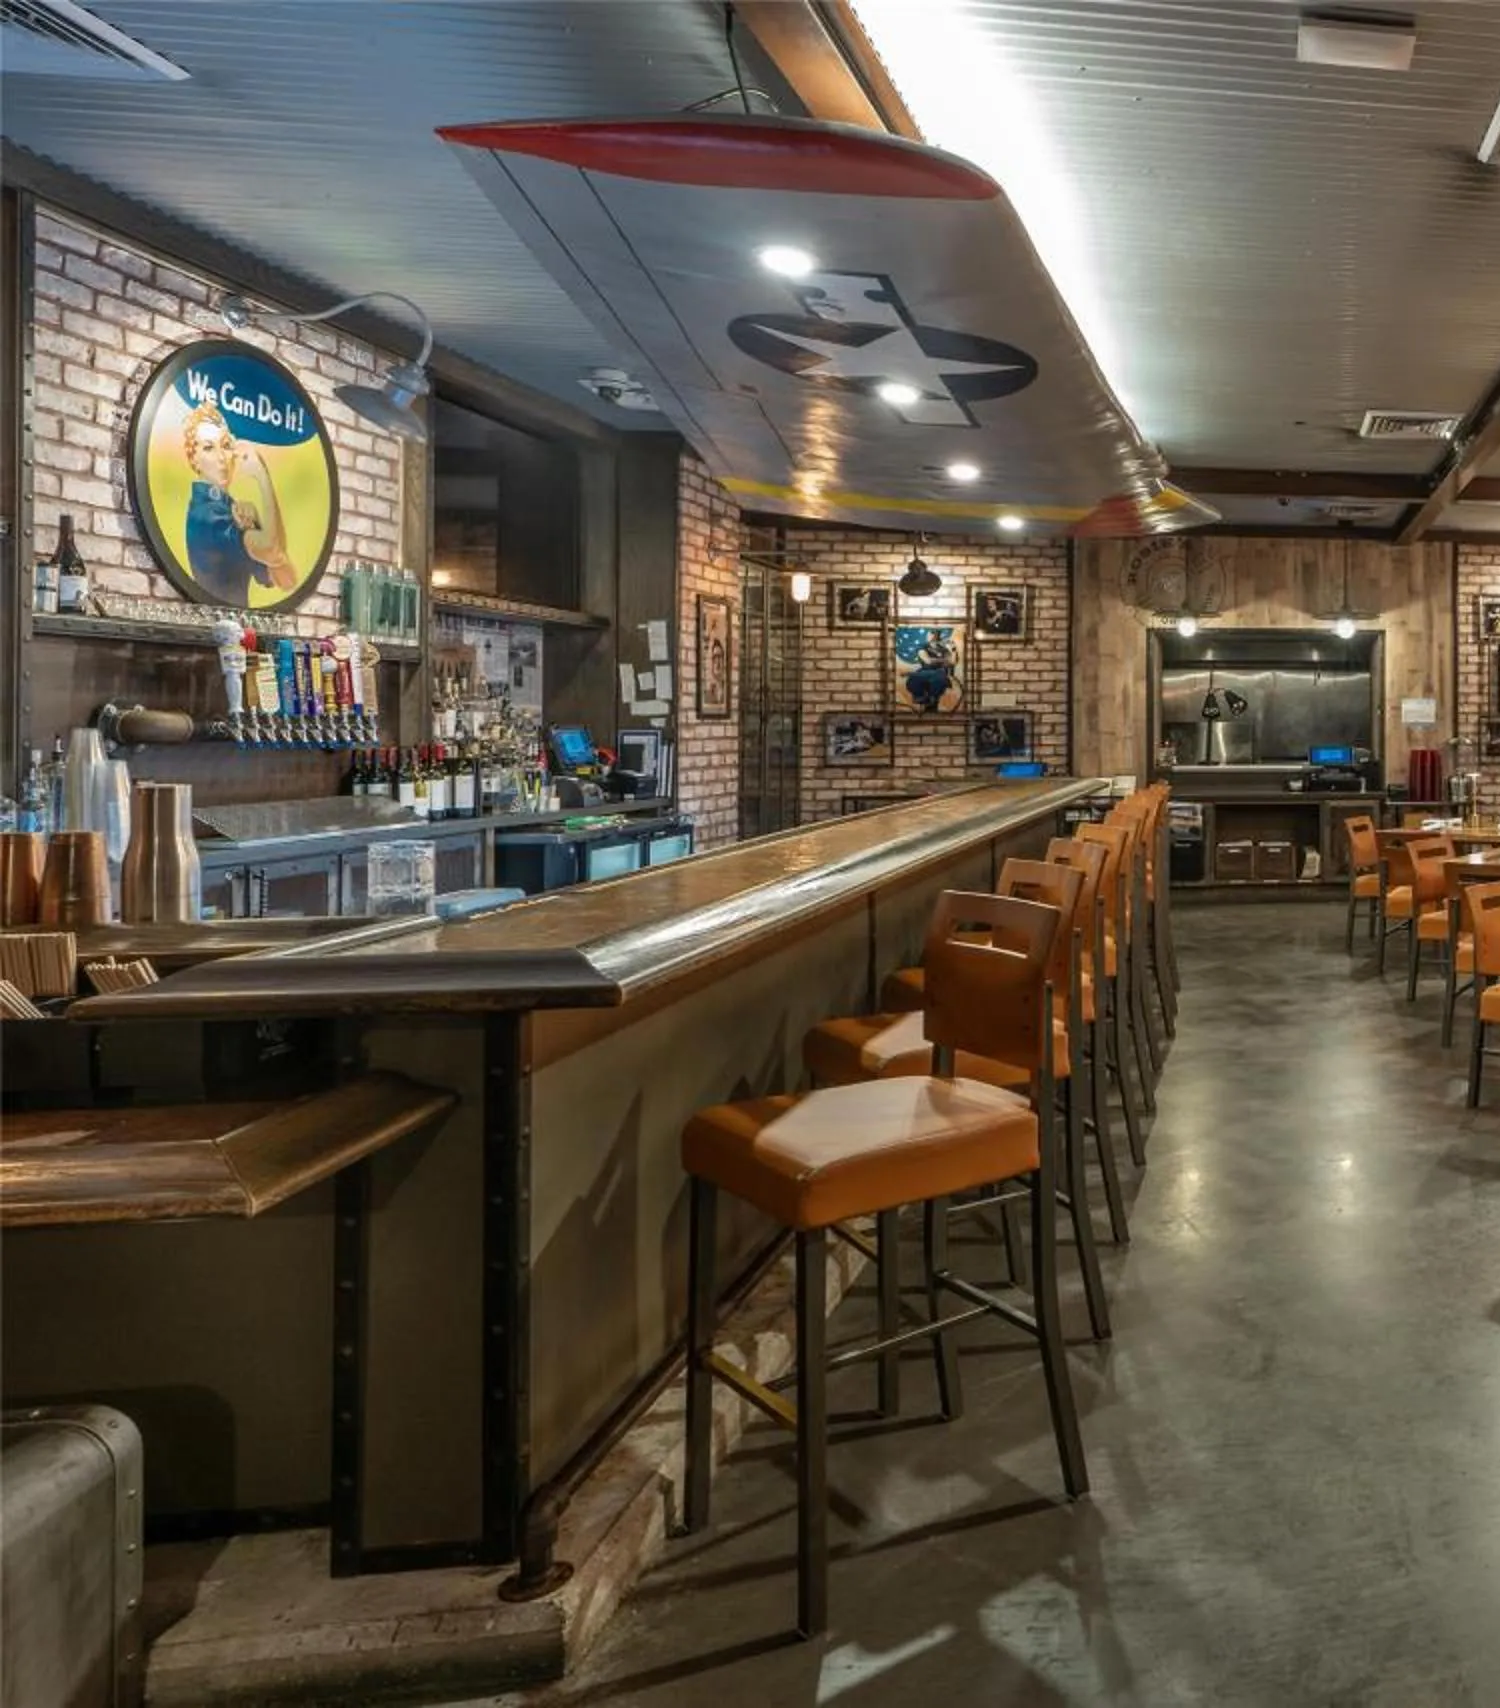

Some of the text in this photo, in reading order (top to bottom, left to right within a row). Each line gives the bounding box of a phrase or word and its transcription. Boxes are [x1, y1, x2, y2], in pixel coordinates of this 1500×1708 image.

[187, 368, 304, 432] We Can Do It!
